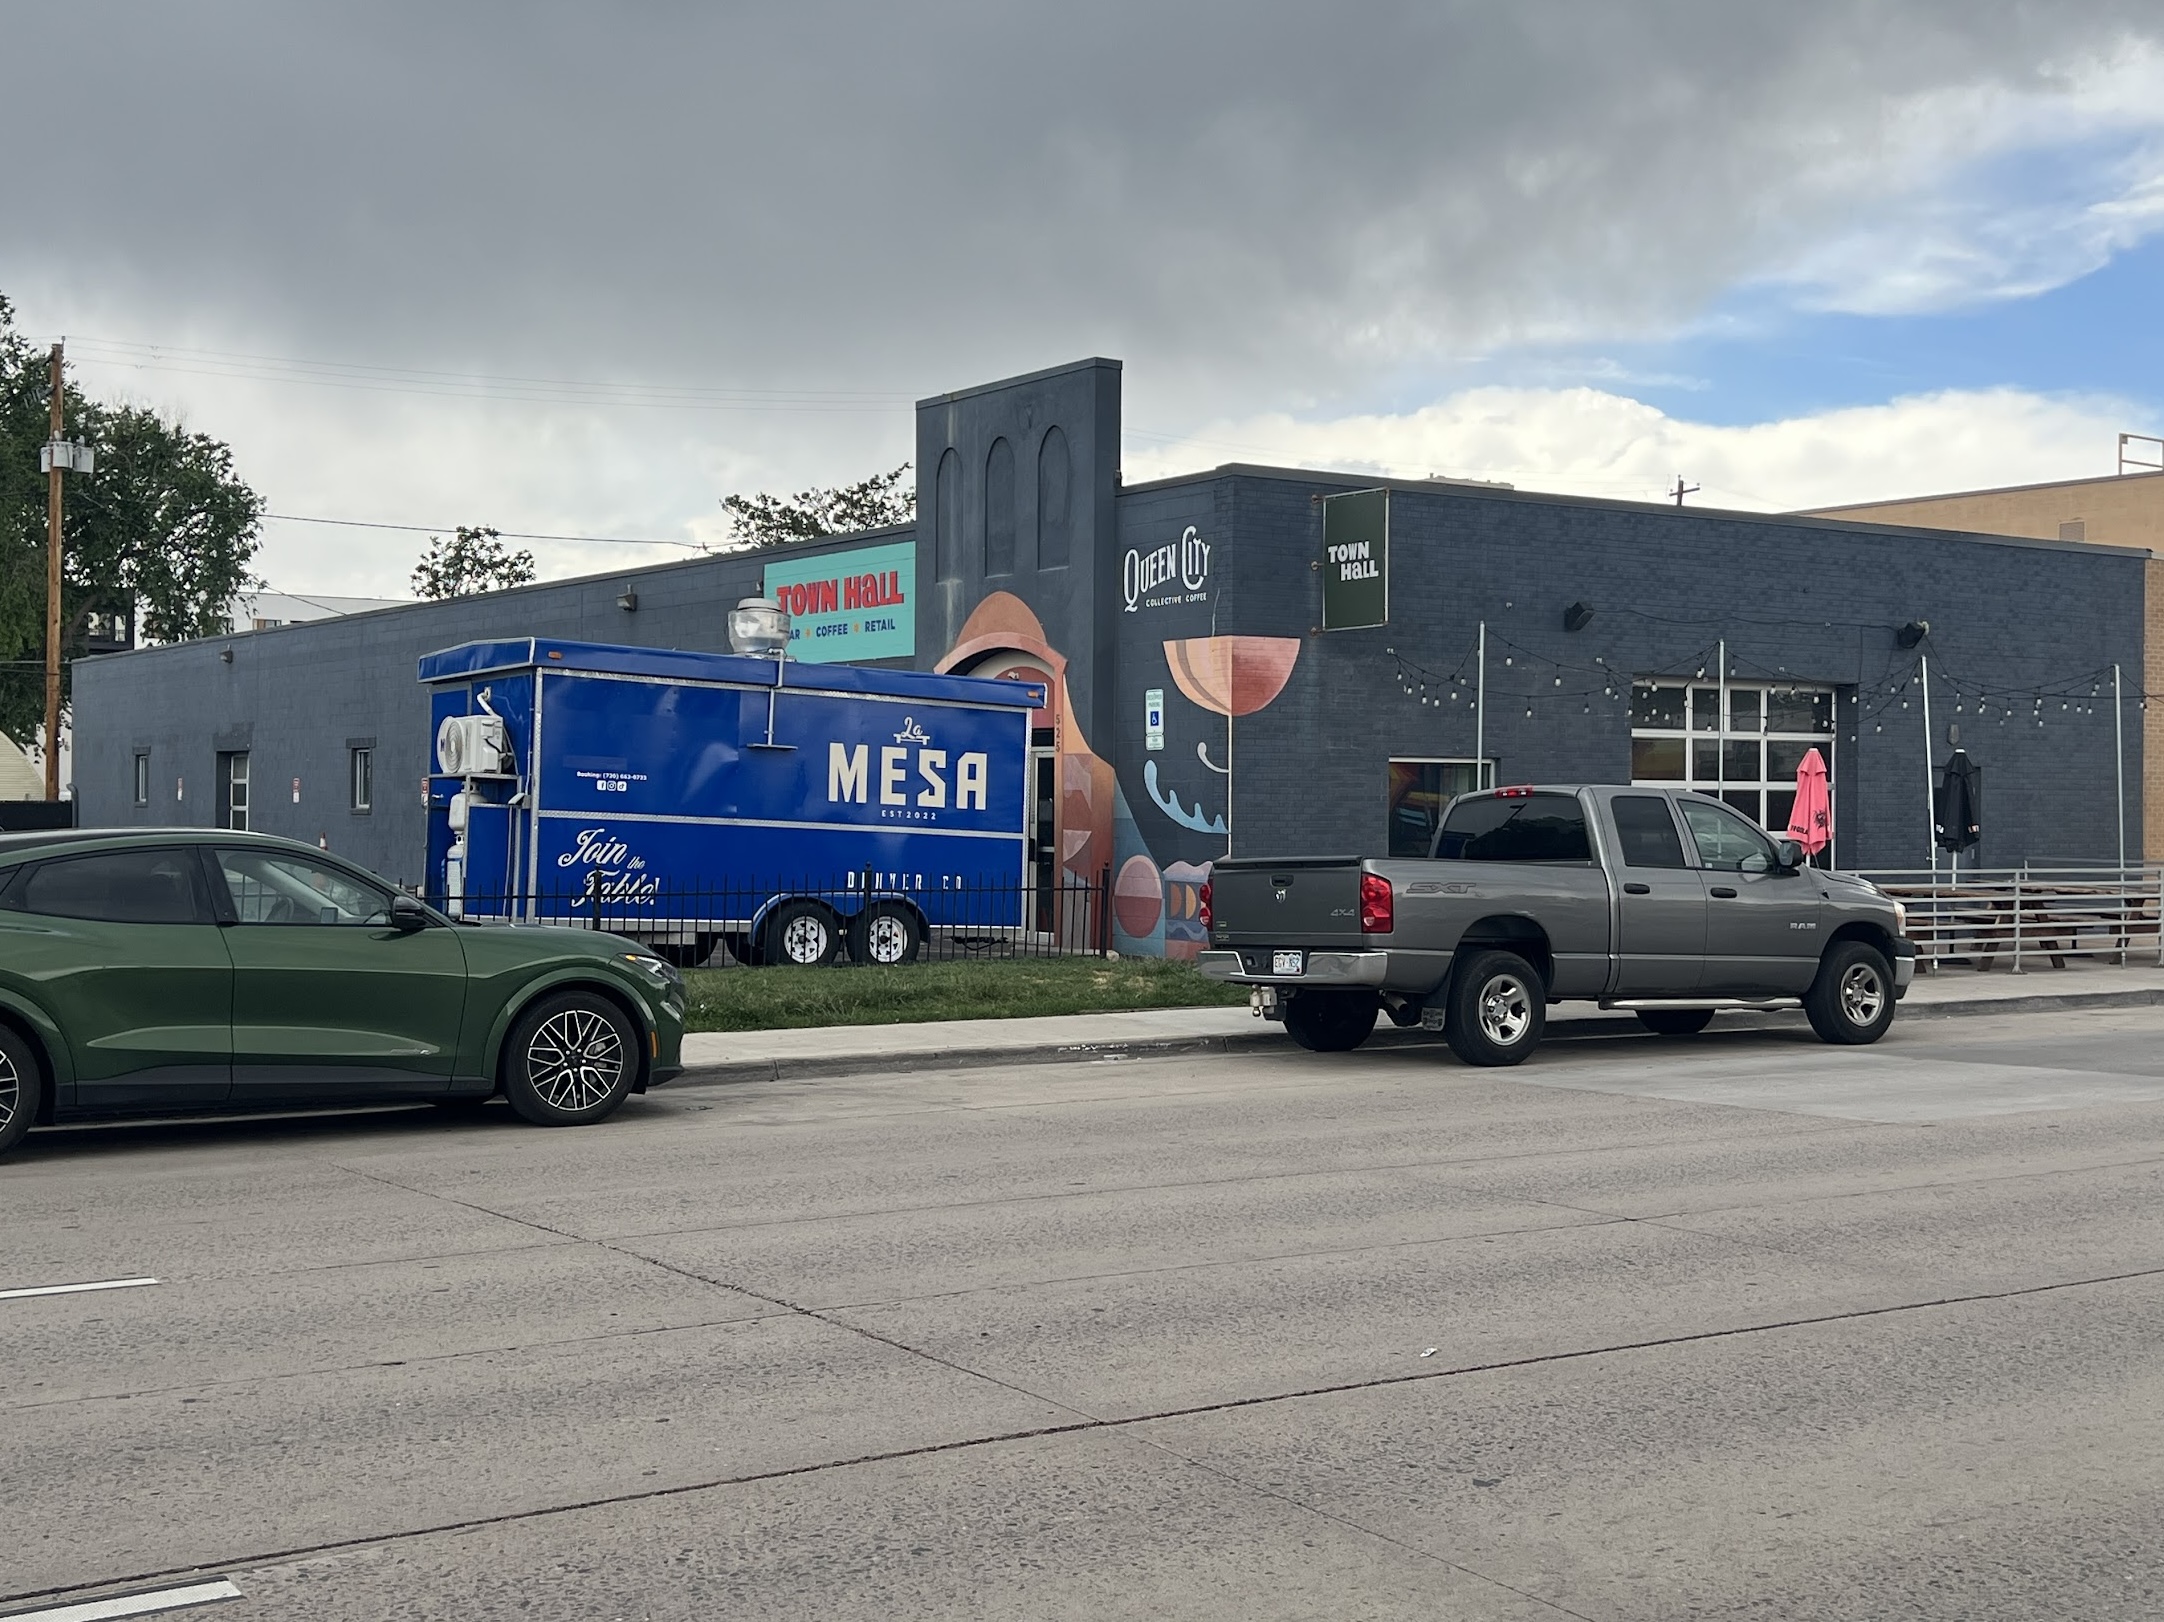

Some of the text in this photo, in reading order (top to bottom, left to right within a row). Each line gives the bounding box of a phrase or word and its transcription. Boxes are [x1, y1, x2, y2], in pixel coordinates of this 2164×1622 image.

[1328, 541, 1369, 563] TOWN
[1124, 526, 1211, 612] QUEEN CITY
[776, 579, 838, 616] TOWN
[1146, 592, 1207, 607] COLLECTIVE COFFEE
[789, 618, 895, 640] AR COFFEE RETAIL
[900, 716, 923, 739] La
[828, 742, 987, 810] MESA
[558, 828, 646, 869] Join the
[1406, 882, 1476, 894] SXT
[1790, 922, 1817, 930] RAM
